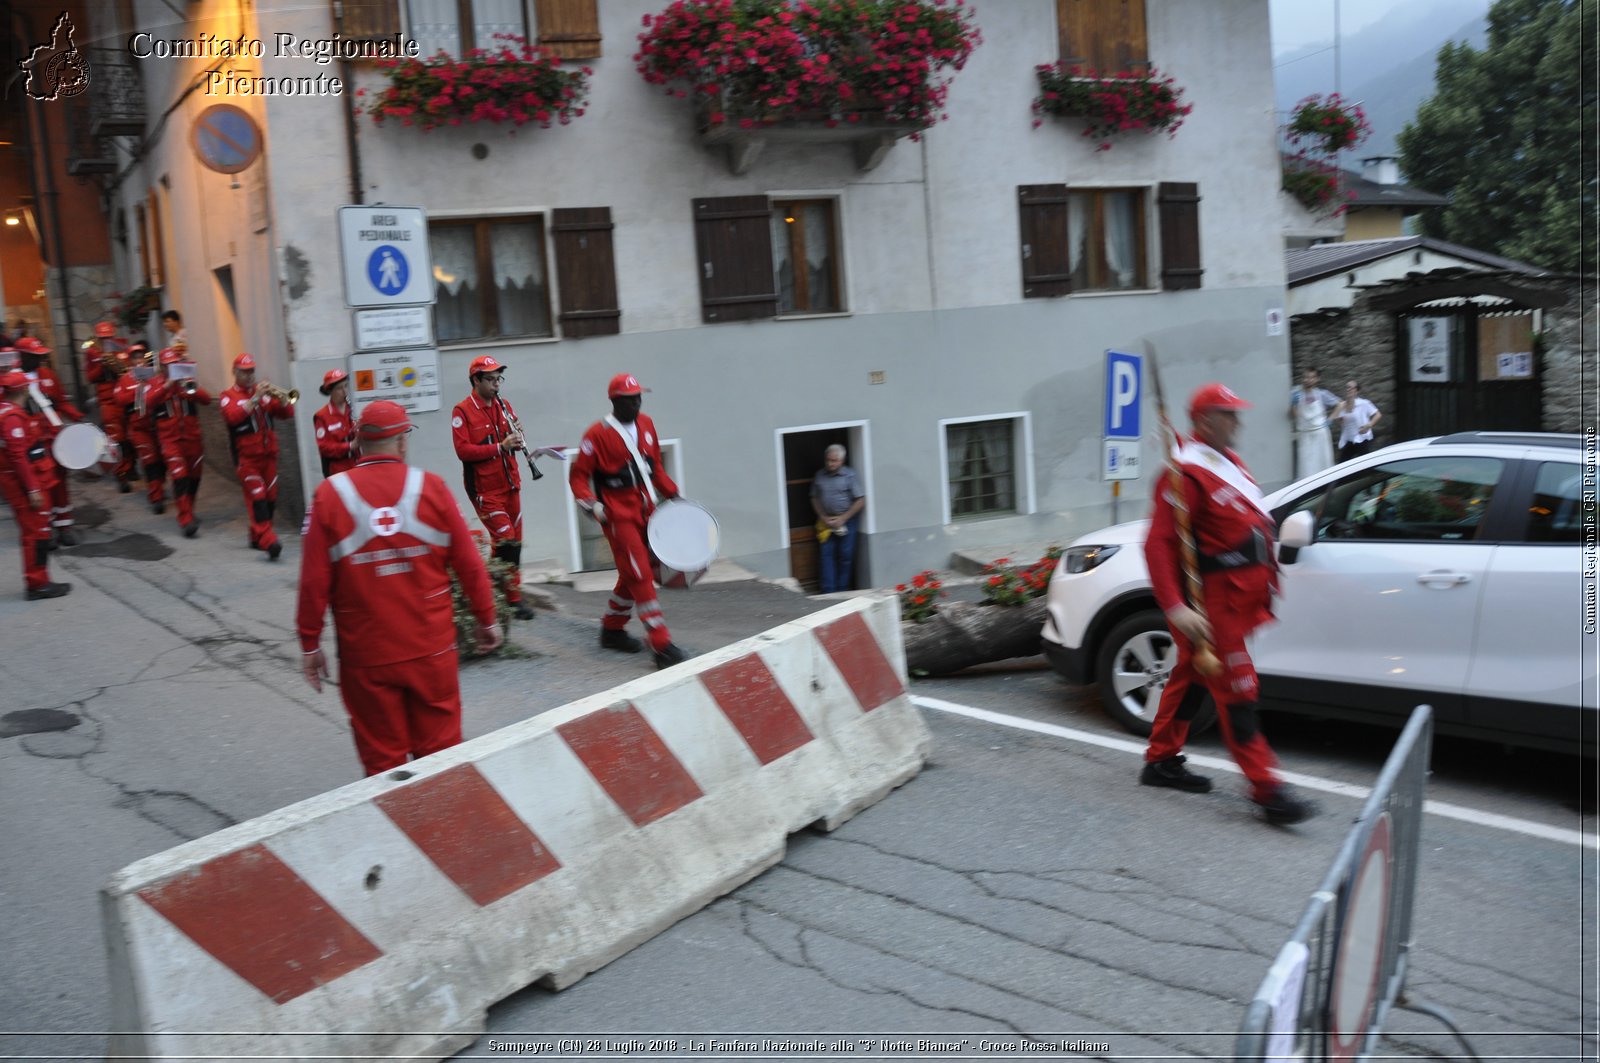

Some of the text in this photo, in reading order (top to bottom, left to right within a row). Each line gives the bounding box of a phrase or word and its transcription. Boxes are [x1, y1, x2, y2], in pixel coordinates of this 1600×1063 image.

[371, 214, 398, 226] AREA
[358, 229, 412, 241] PEDONALE
[1111, 360, 1138, 429] P
